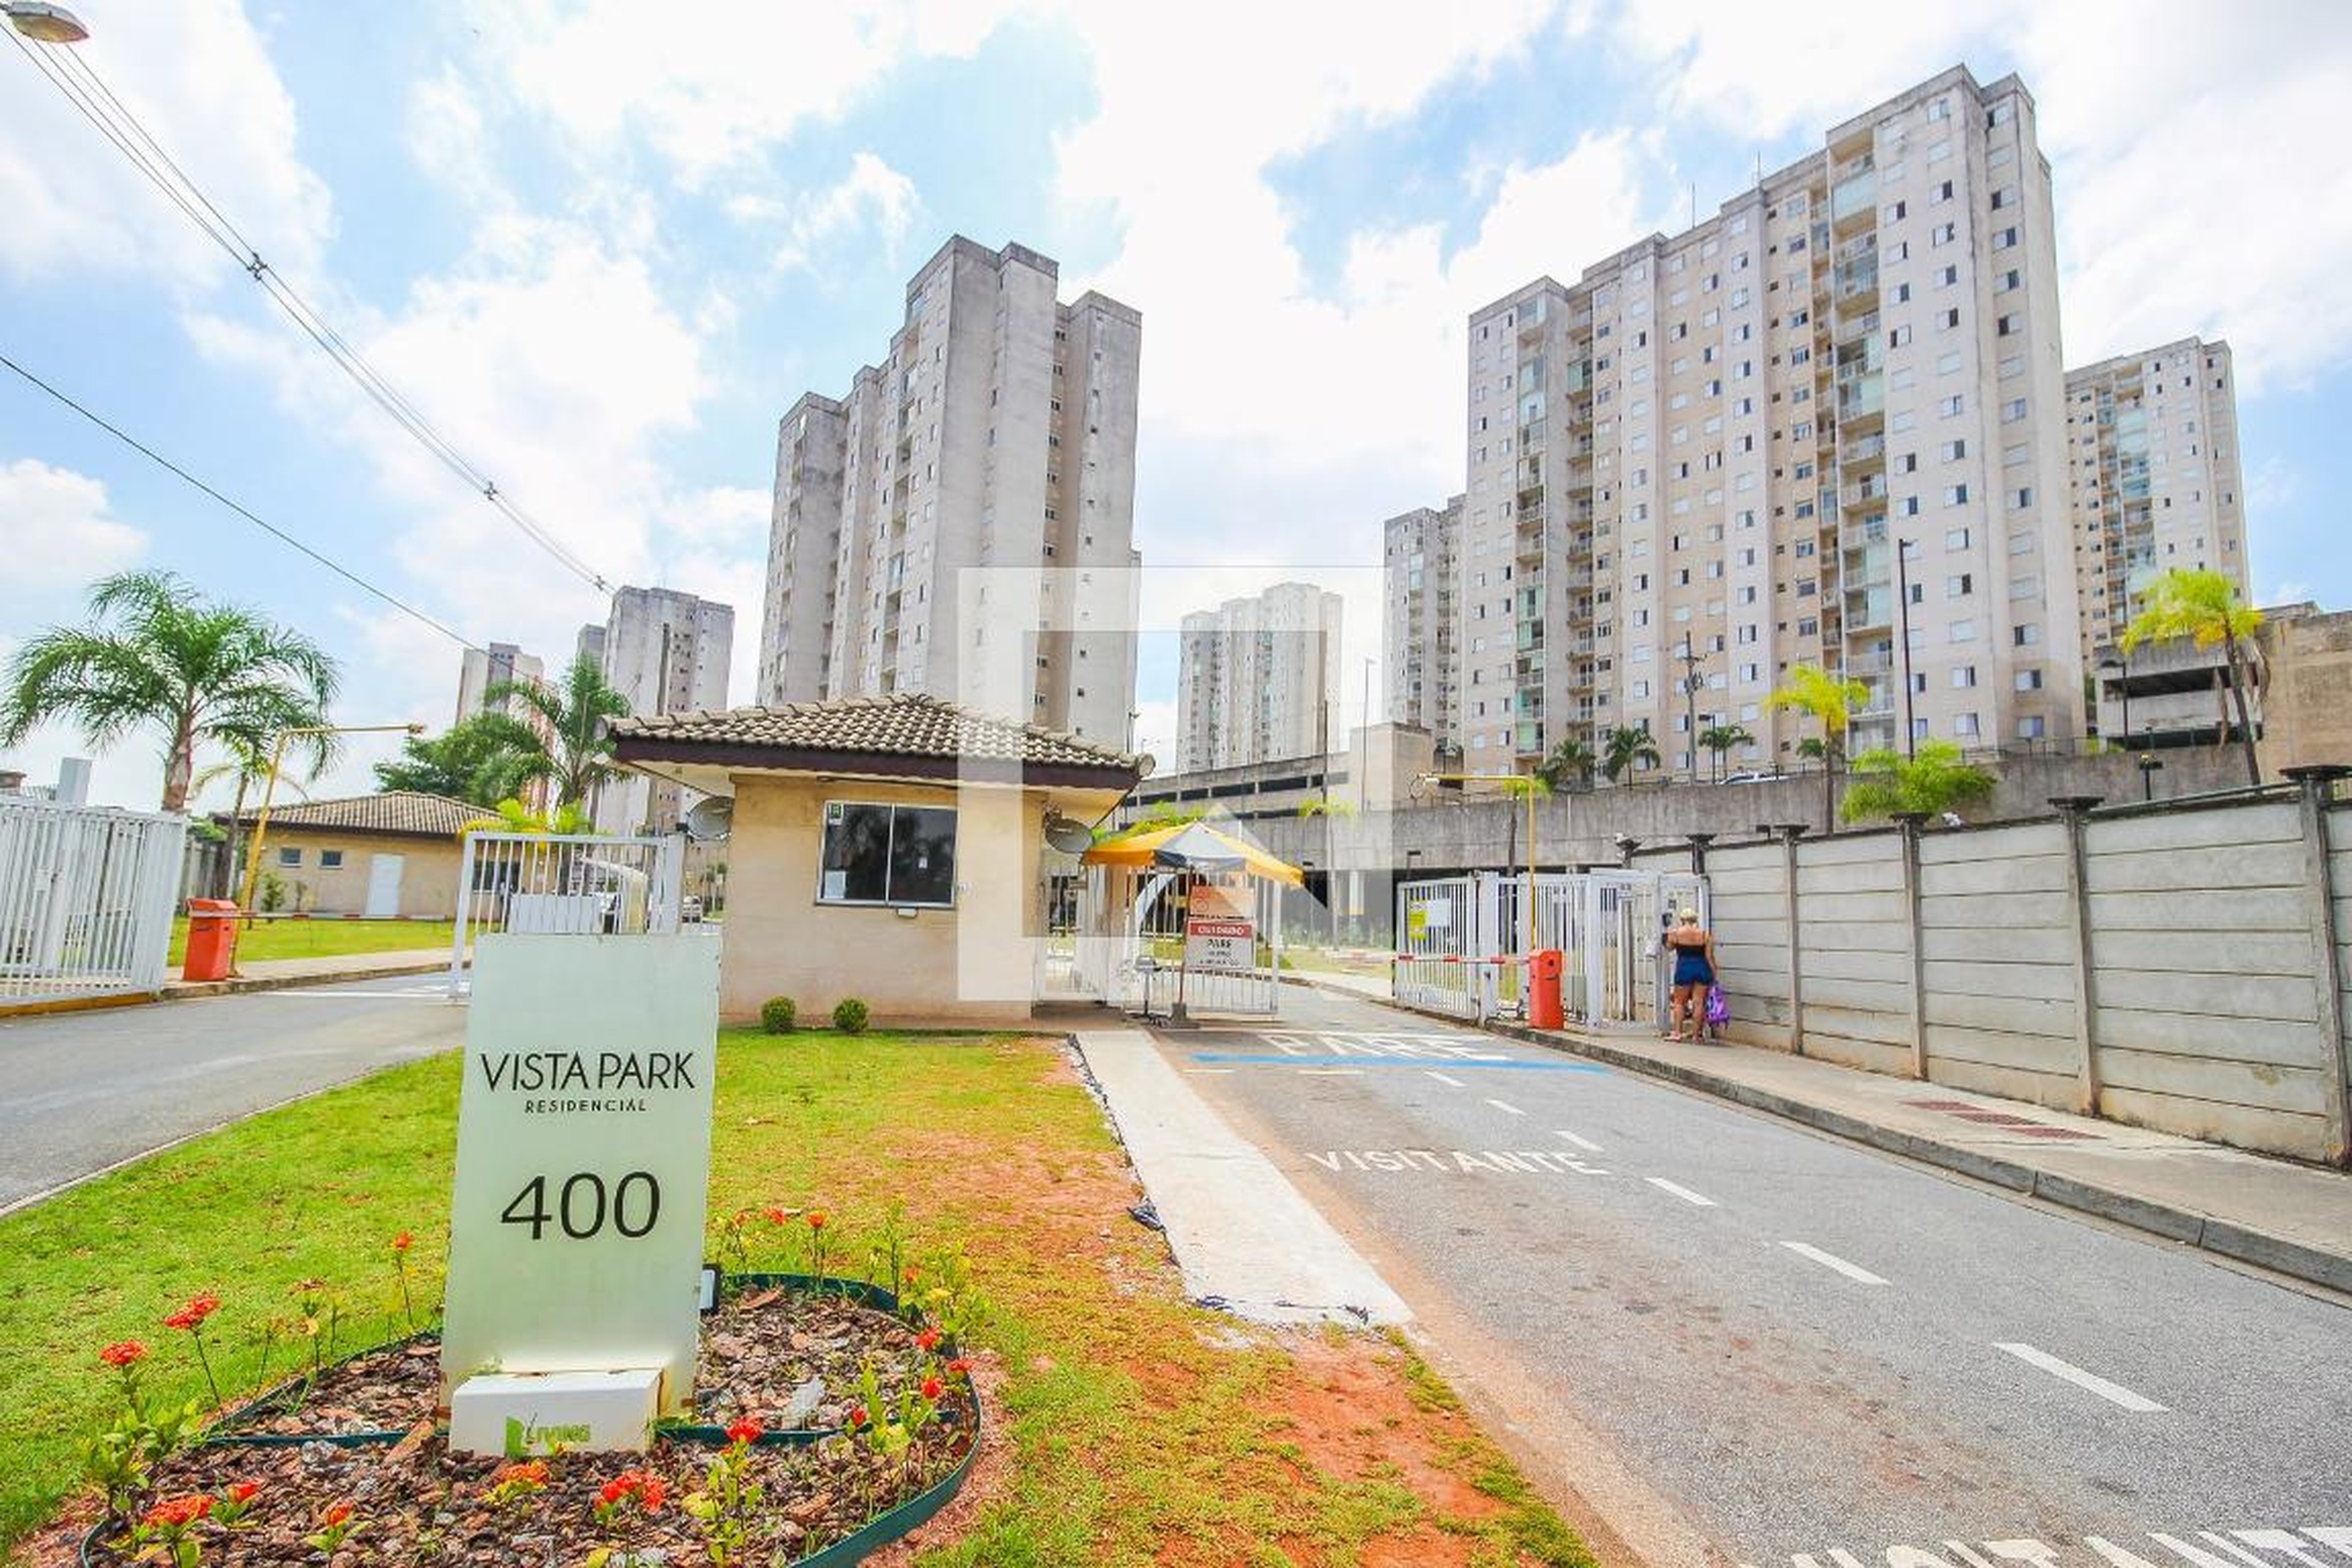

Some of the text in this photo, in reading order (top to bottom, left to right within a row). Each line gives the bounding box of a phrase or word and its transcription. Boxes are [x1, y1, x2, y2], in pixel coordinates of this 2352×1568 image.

[1258, 1034, 1512, 1061] PARE
[481, 1052, 696, 1091] VISTA PARK
[525, 1099, 646, 1114] RESIDENCIAL
[1306, 1149, 1611, 1176] VISITANTE
[500, 1171, 660, 1240] 400
